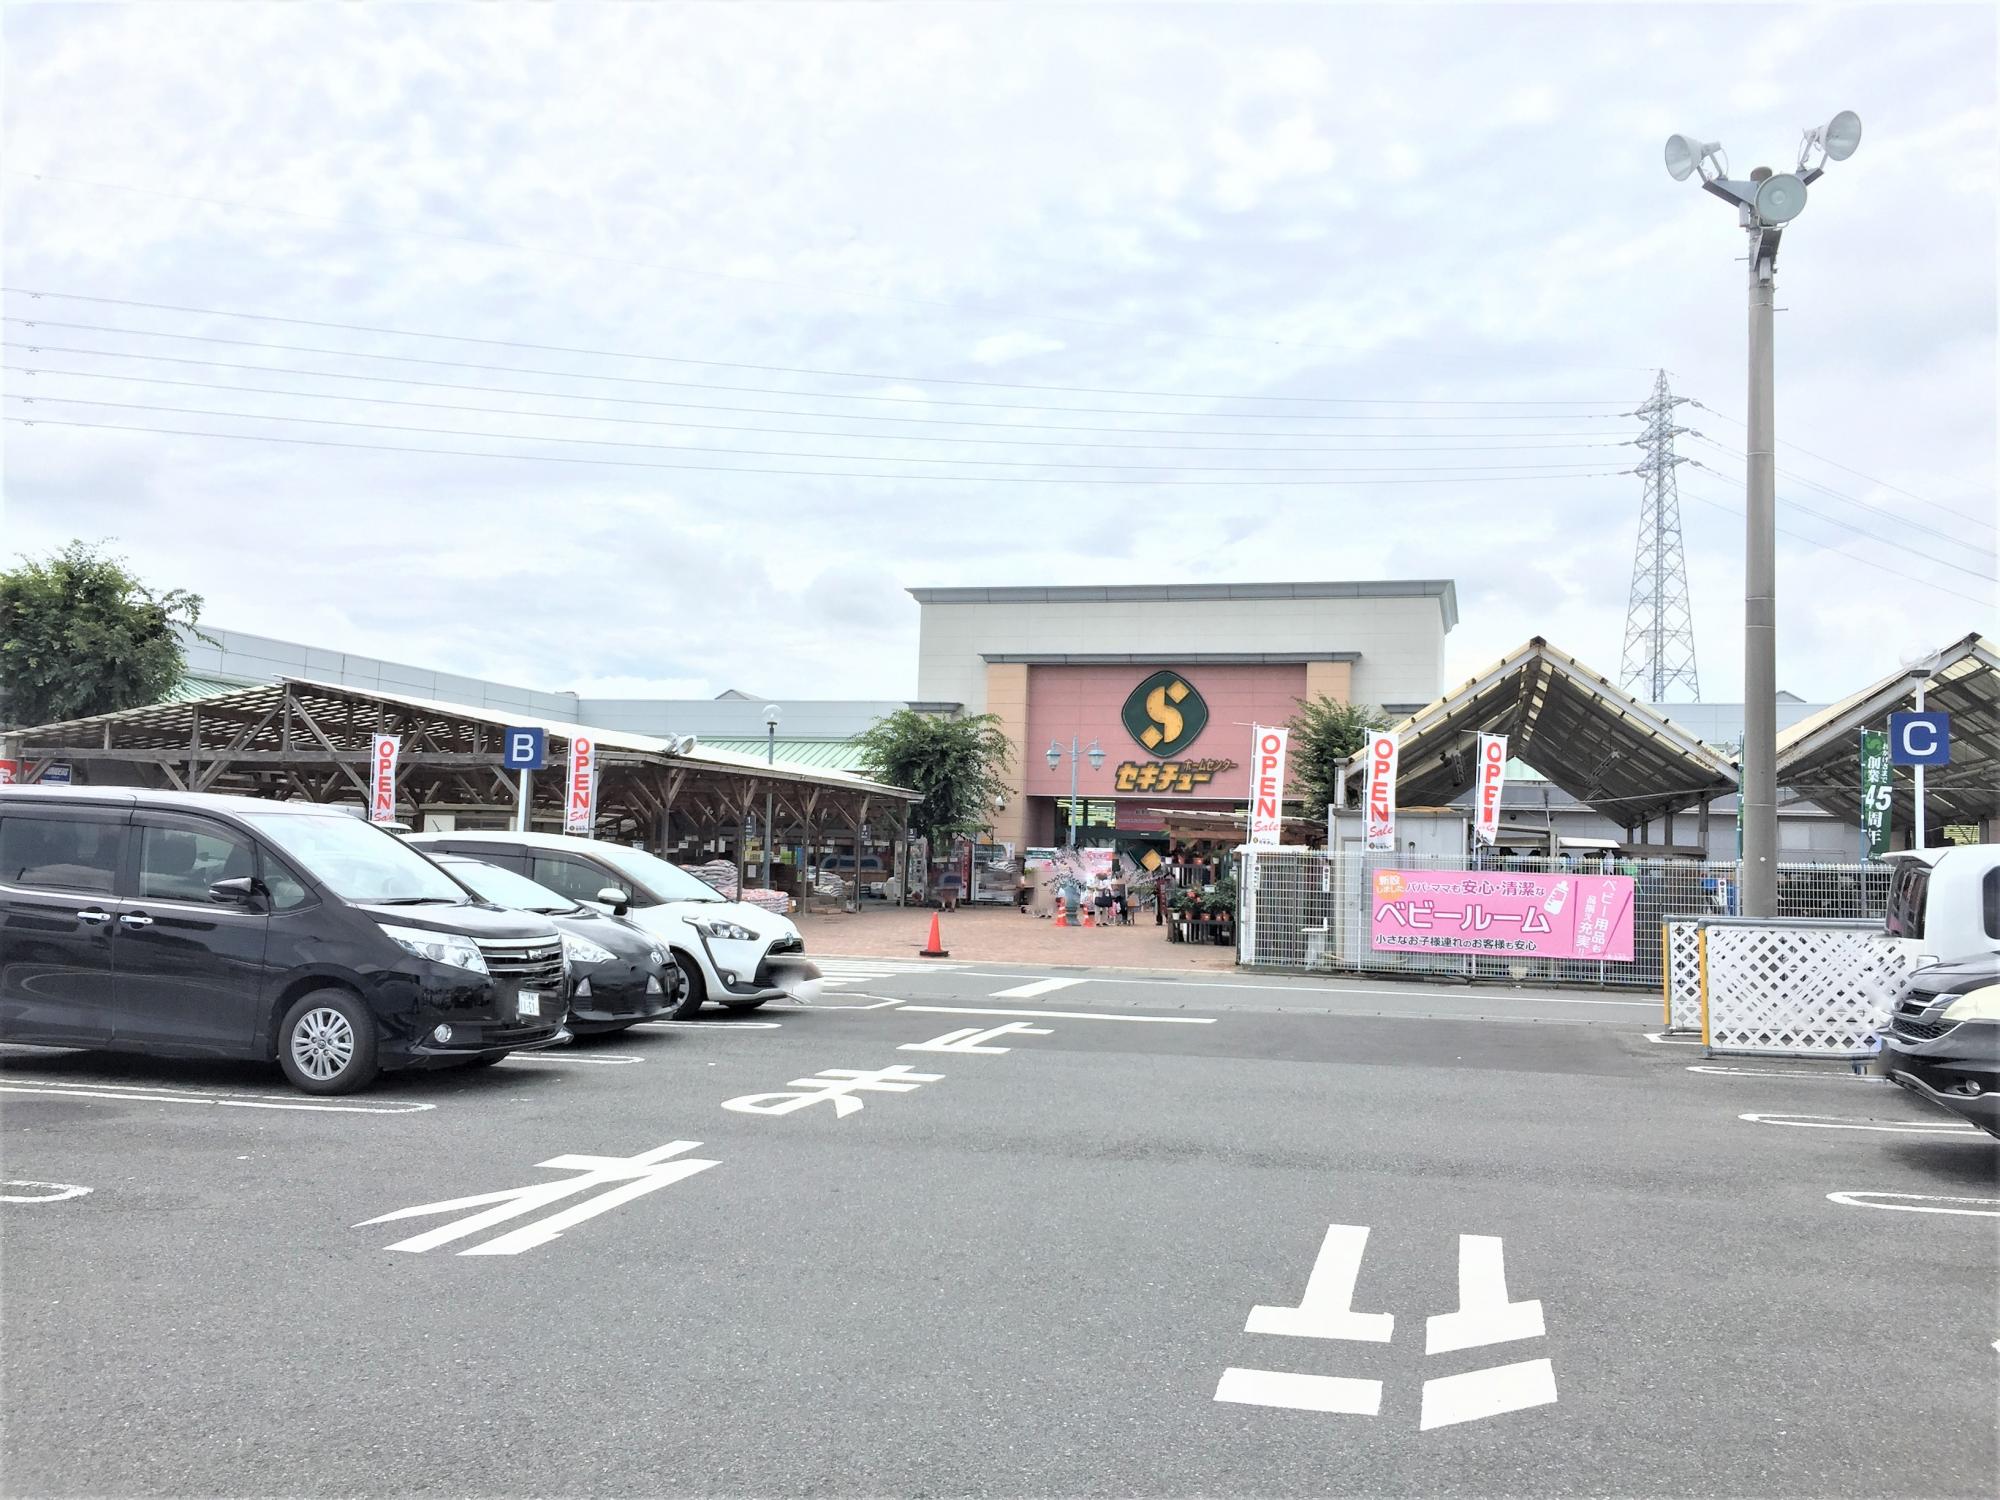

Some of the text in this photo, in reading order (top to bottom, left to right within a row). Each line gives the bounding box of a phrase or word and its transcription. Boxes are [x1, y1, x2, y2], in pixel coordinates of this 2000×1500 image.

[512, 733, 534, 762] B
[1903, 720, 1938, 757] C
[376, 740, 395, 811] OPEN
[572, 737, 590, 809] OPEN
[1115, 761, 1214, 793] セキチュー
[1184, 759, 1238, 773] ホームセンター
[1256, 734, 1282, 819] OPEN
[1370, 738, 1394, 823] OPEN
[1253, 820, 1280, 833] Sale
[1369, 824, 1394, 838] Sale
[1378, 875, 1401, 886] 新設
[1375, 900, 1552, 934] ベビールーム
[1375, 934, 1537, 951] 小さなお子様連れのお客様も安心
